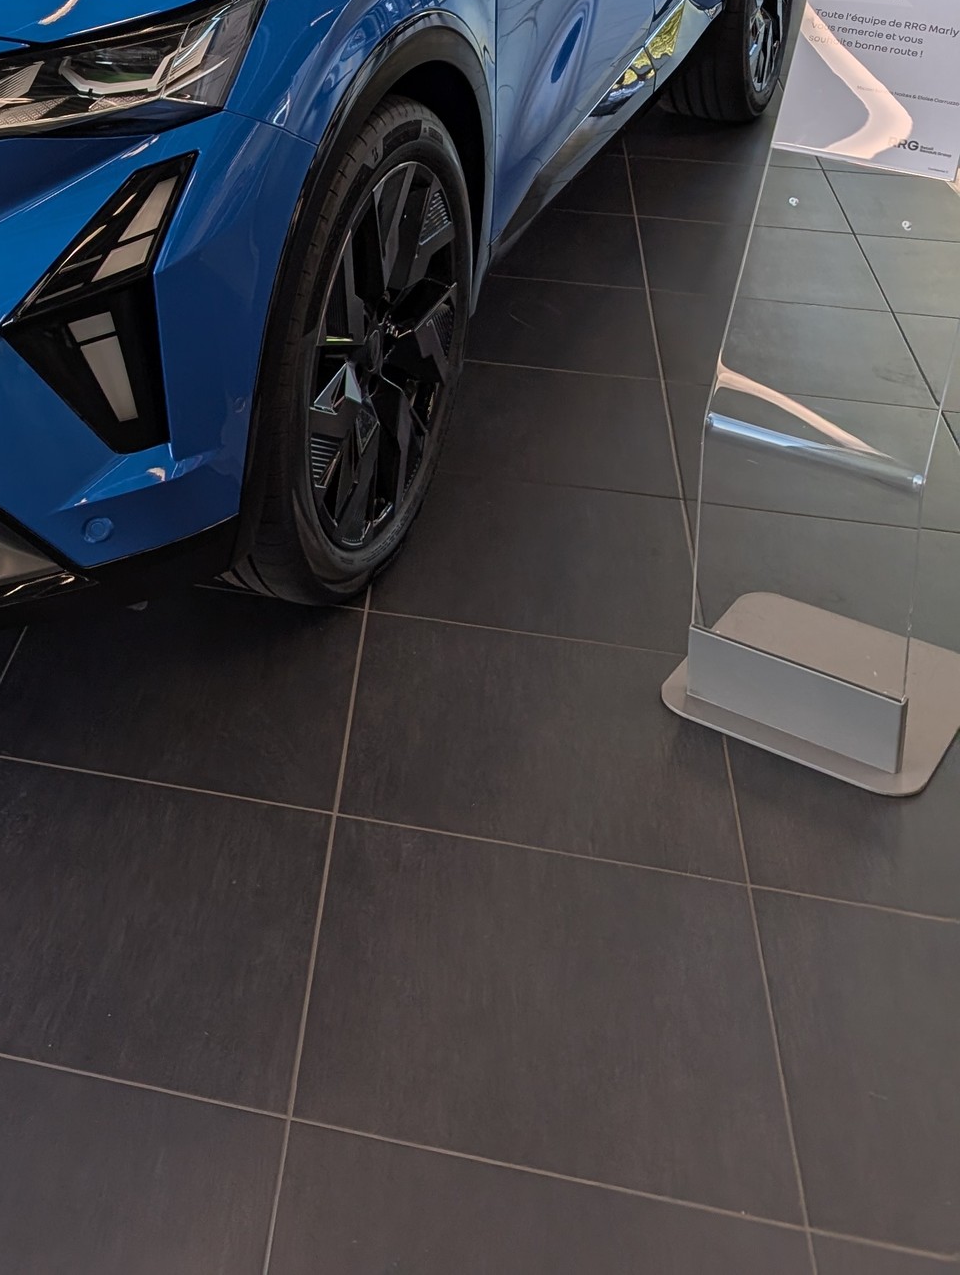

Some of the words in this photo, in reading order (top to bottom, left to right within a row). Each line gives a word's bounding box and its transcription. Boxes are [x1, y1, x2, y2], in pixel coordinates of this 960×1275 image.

[811, 22, 836, 32] vous
[837, 26, 884, 39] remercie
[885, 33, 897, 41] et
[898, 35, 924, 45] vous
[815, 8, 844, 20] Toute
[845, 12, 887, 26] l'équipe
[888, 19, 903, 28] de
[904, 21, 927, 32] RRG
[928, 25, 960, 38] Marly
[854, 40, 888, 52] bonne
[889, 47, 919, 57] route
